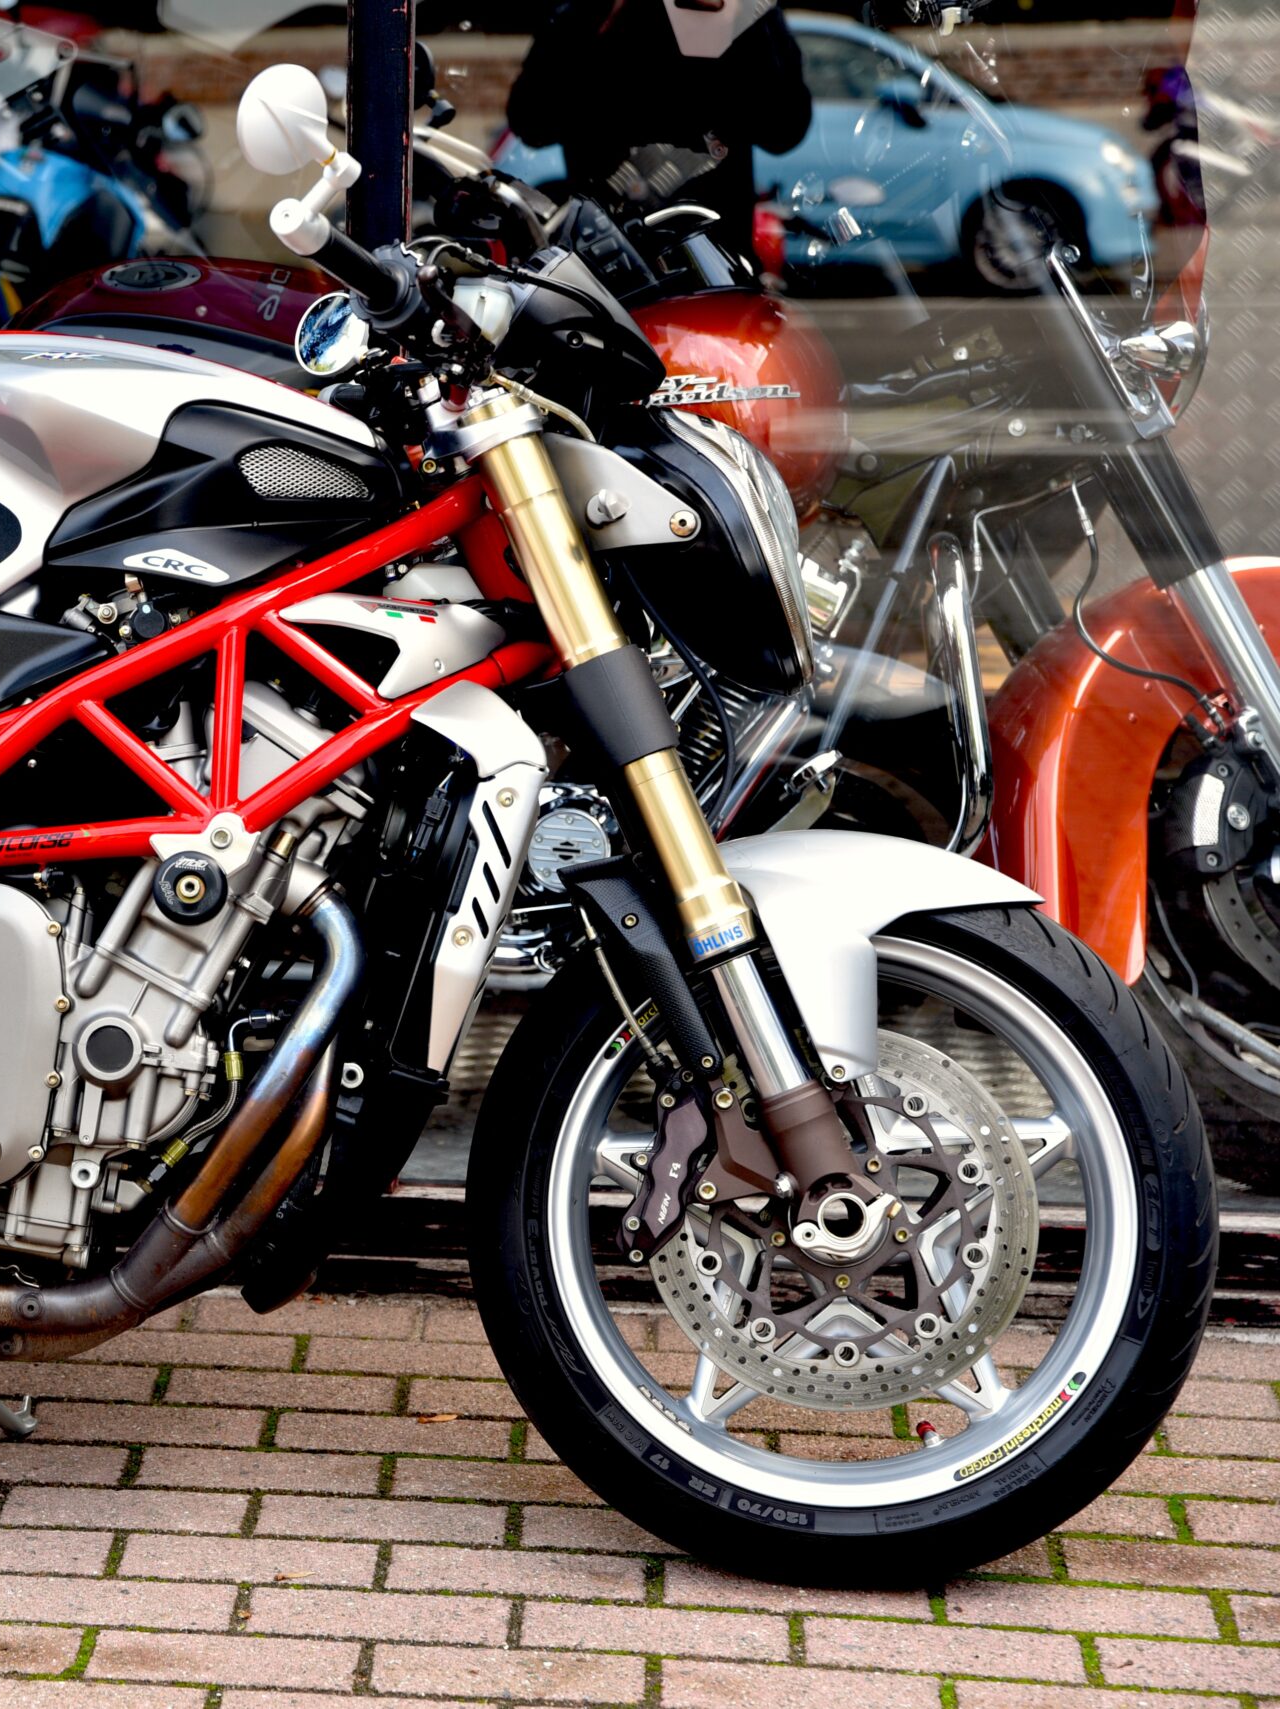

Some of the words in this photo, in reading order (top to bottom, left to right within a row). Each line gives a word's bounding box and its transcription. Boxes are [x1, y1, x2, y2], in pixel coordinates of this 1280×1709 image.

[646, 382, 801, 408] avidson
[142, 555, 208, 577] CRC
[1003, 1397, 1063, 1457] marchesini
[647, 1448, 673, 1472] 17
[959, 1450, 1004, 1478] FORGED
[685, 1473, 718, 1498] ZR
[733, 1496, 810, 1526] 120/70
